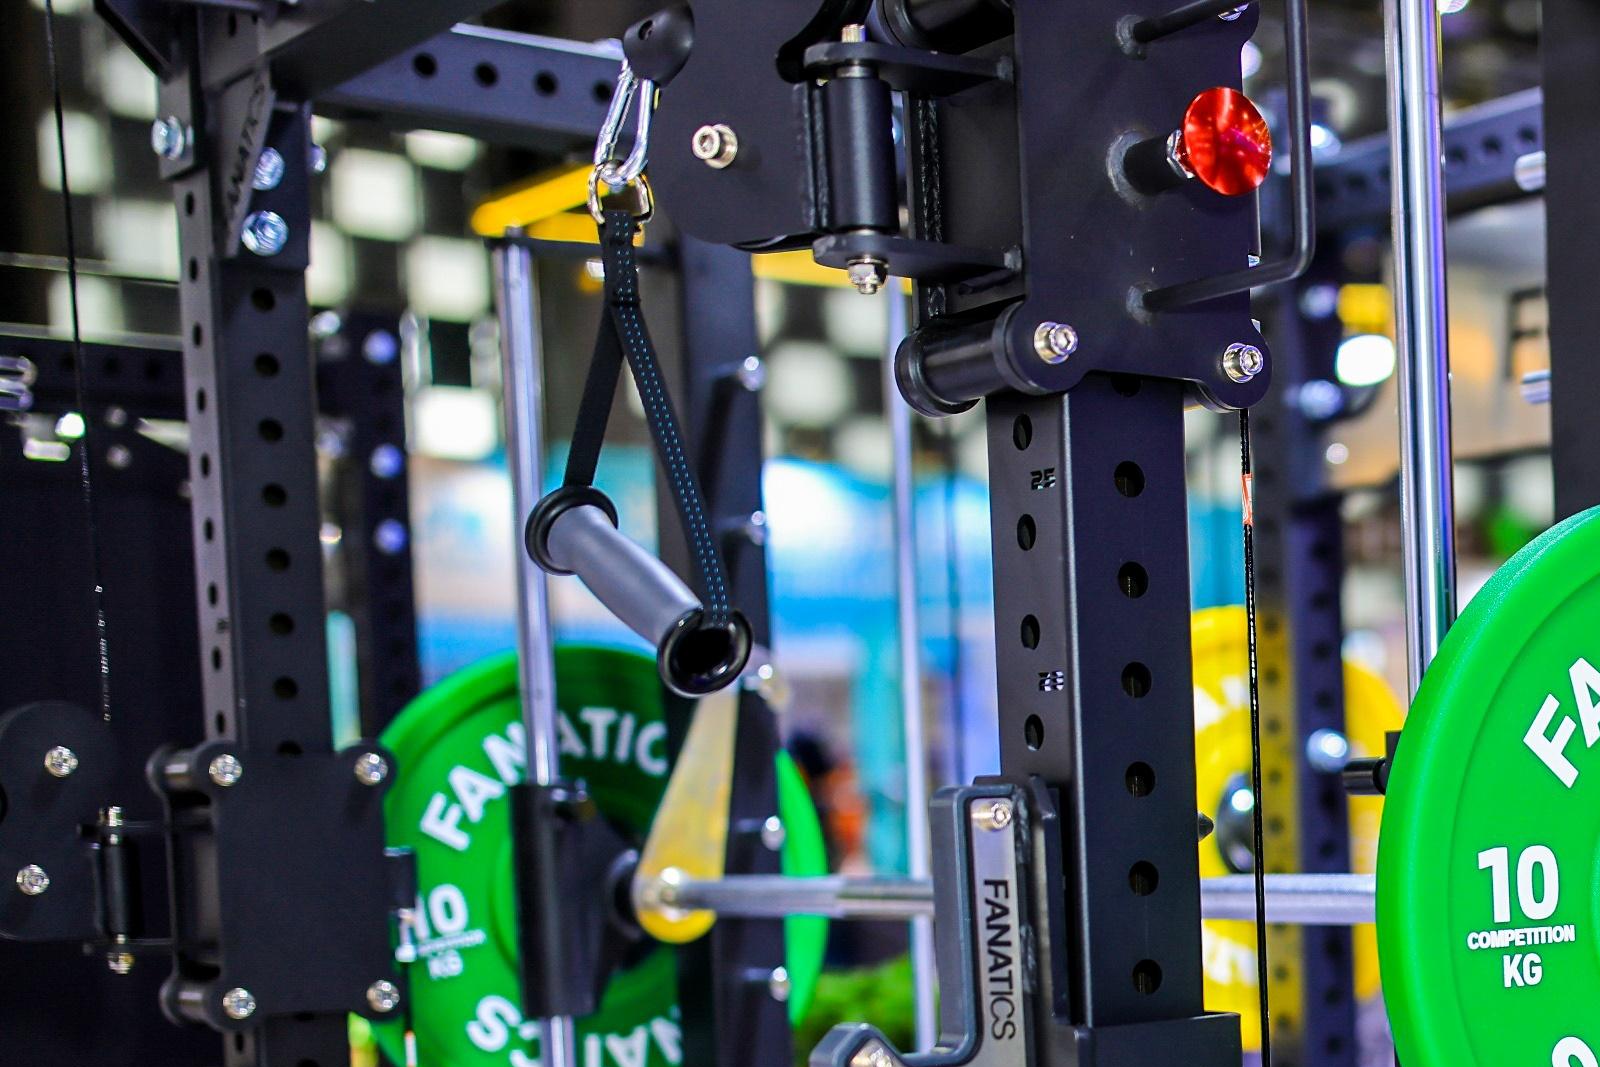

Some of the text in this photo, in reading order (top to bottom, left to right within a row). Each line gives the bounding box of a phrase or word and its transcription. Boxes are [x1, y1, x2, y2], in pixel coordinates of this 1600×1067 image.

[1030, 467, 1056, 490] 25
[1477, 845, 1560, 923] 10
[1466, 924, 1576, 950] COMPETITION
[983, 879, 1017, 1041] FANATICS
[1502, 952, 1543, 988] KG
